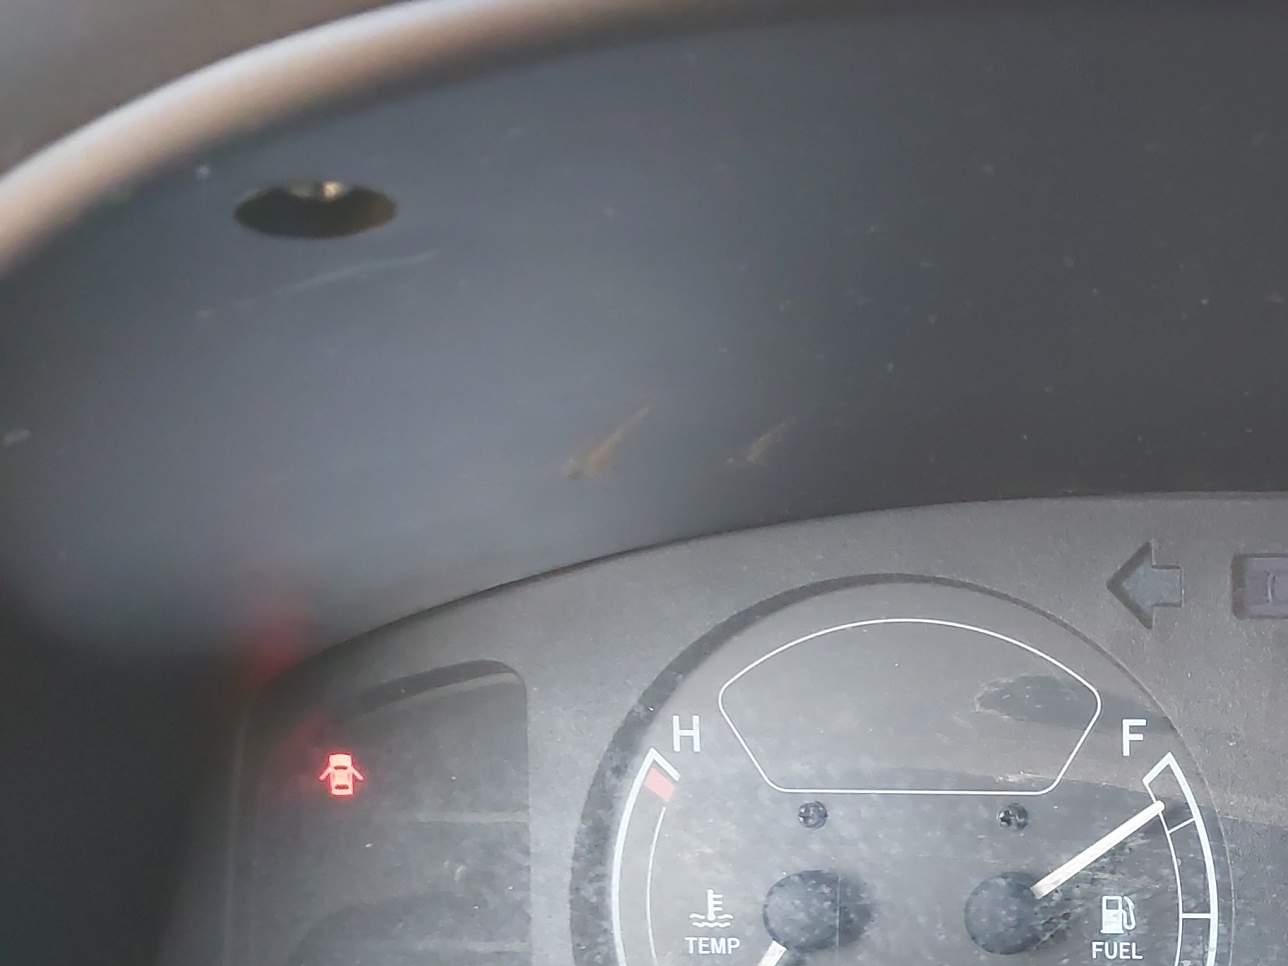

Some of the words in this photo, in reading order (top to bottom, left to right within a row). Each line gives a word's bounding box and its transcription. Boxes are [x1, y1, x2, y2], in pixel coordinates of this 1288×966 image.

[672, 715, 701, 752] H
[1122, 718, 1147, 757] F
[684, 936, 741, 955] TEMP
[1091, 941, 1143, 960] FUEL
